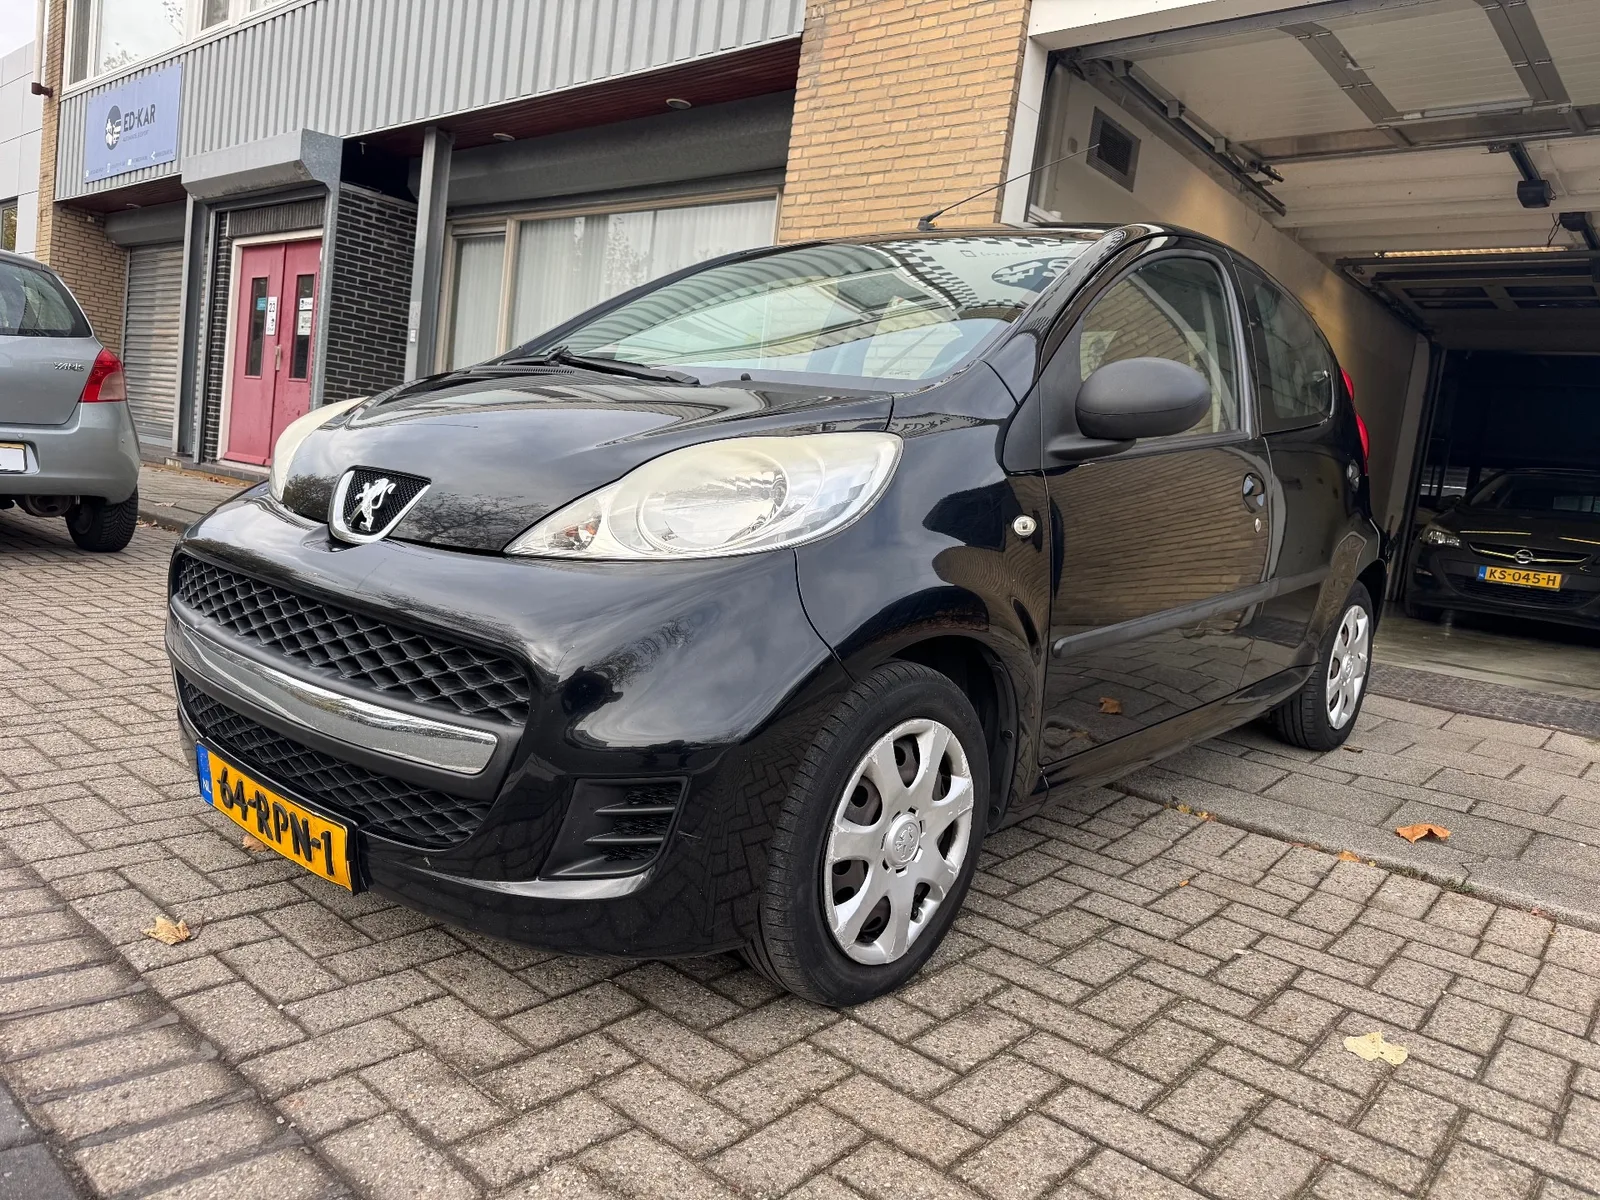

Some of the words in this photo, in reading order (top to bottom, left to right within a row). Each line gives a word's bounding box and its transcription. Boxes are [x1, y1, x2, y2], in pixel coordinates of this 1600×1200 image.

[123, 103, 156, 133] ED-KAR
[268, 302, 276, 313] 23
[1488, 568, 1557, 587] KS-045-H
[202, 778, 212, 795] NL
[217, 767, 335, 877] 64-RPN-1
